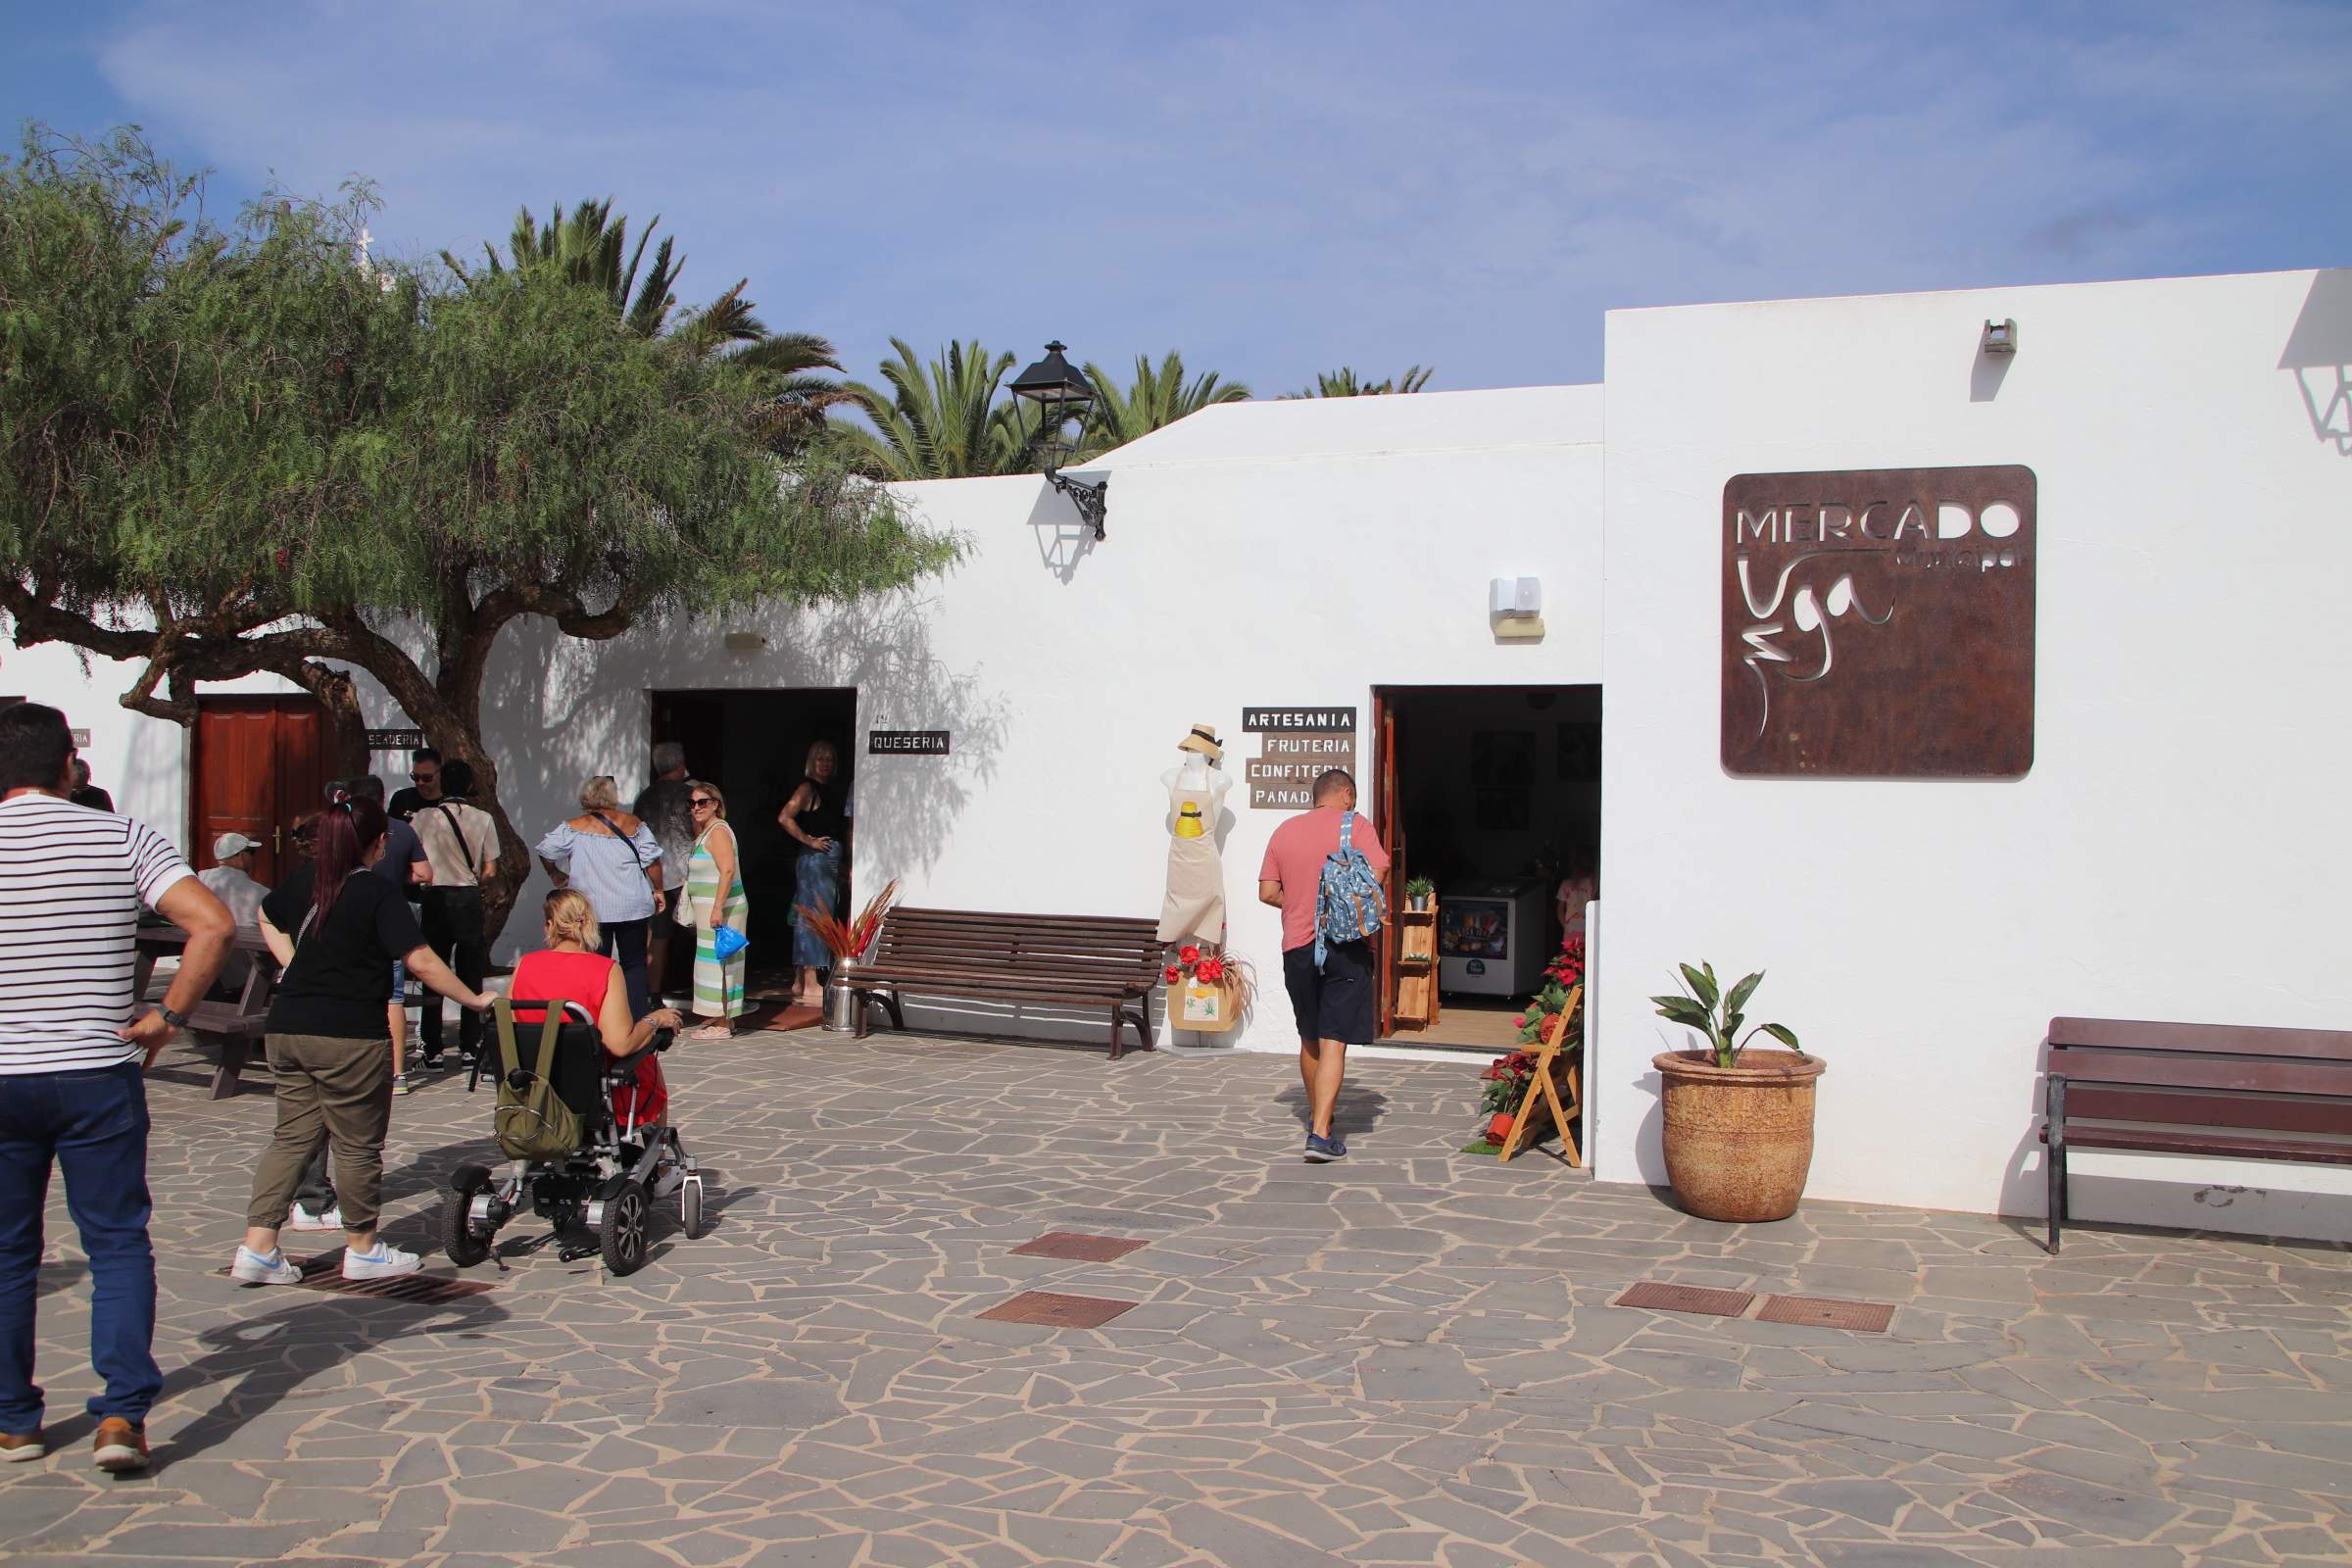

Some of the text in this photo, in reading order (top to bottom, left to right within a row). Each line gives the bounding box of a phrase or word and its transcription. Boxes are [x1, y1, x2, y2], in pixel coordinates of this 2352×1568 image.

[1737, 500, 2021, 543] MERCADO
[1248, 713, 1350, 727] ARTESANIA
[368, 734, 419, 745] SCADERIA
[874, 737, 944, 749] QUESERIA
[1267, 739, 1350, 753] FRUTERIA
[1255, 790, 1313, 803] PANAD
